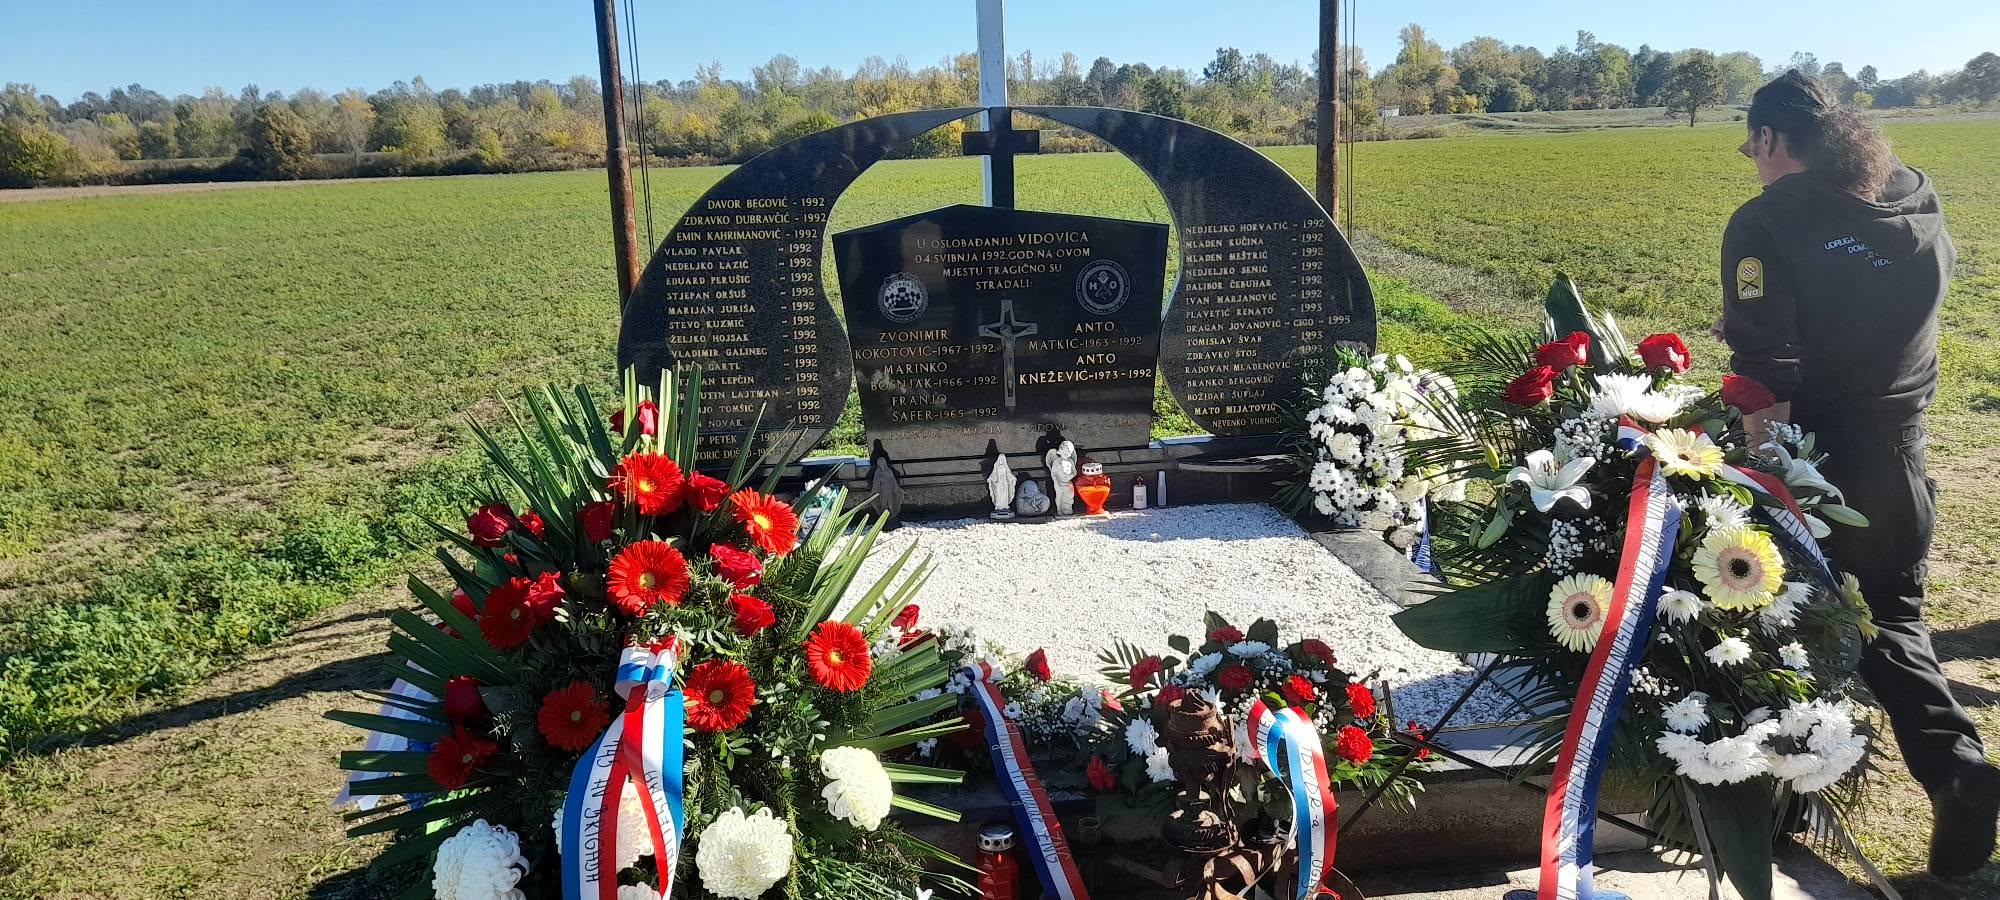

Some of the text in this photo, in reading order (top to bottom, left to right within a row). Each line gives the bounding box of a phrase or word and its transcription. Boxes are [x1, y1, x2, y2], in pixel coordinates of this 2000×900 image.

[708, 196, 824, 209] DAVOR BEGOVIĆ 1992
[684, 212, 827, 226] ZDRAVKO DUBRAVČIĆ 1992
[1185, 219, 1325, 234] NEDJELJKO HORVATIĆ 1992
[677, 229, 818, 242] EMIN KAHRIMANOVIĆ 1992
[917, 232, 1089, 249] U OSLOBAĐANJU VIDOVICA
[1185, 233, 1323, 248] MLADEN KUČINA 1992
[1824, 236, 1856, 250] UDRUGA
[664, 244, 812, 256] VLADO PAVLAK 1992
[1056, 248, 1091, 258] OVOM
[1185, 247, 1323, 262] MLADEN MEŠTRIĆ 1992
[665, 258, 813, 271] NEDELJKO LAZIĆ 1992
[942, 263, 1062, 278] MJESTU TRAGIČNO SU
[1185, 261, 1323, 278] NEDJELJKO SENIĆ 1992
[666, 277, 706, 286] EDUARD
[790, 273, 814, 282] 1992
[975, 279, 1033, 290] STRADALI:
[1185, 282, 1223, 291] DALIBOR
[1300, 275, 1322, 284] 1992
[666, 287, 815, 300] STJEPAN ORŠUŠ 1992
[1185, 289, 1322, 306] IVAN MARJANOVIĆ 1992
[668, 301, 816, 315] MARIJAN JURIŠA 1992
[1236, 306, 1274, 316] RENATO
[1300, 303, 1322, 312] 1993
[668, 321, 700, 330] STEVO
[792, 316, 816, 325] 1992
[1074, 321, 1115, 333] ANTO
[1186, 324, 1224, 333] DRAGAN
[1229, 318, 1281, 331] JOVANOVIĆ
[1328, 316, 1350, 326] 1995
[670, 334, 706, 344] ŽELJKO
[793, 330, 817, 340] 1992
[879, 330, 950, 343] ZVONIMIR
[1120, 336, 1143, 346] 1992
[1186, 330, 1323, 347] TOMISLAV ŠVAB 1993
[671, 344, 817, 358] VLADIMIR GALINEC 1992
[1186, 351, 1230, 360] ZDRAVKO
[794, 358, 818, 368] 1992
[1076, 353, 1116, 366] ANTO
[884, 362, 948, 375] MARINKO
[1128, 368, 1152, 379] 1992
[1185, 364, 1230, 374] RADOVAN
[721, 374, 755, 385] LEPČIN
[795, 372, 819, 382] 1992
[1187, 378, 1224, 388] BRANKO
[731, 390, 779, 399] LAJTMAN
[796, 386, 820, 396] 1992
[797, 400, 821, 410] 1992
[892, 393, 948, 407] FRANJO
[974, 408, 998, 417] 1992
[1194, 406, 1220, 416] MATO
[708, 418, 744, 428] NOVAK
[798, 414, 822, 424] 1992
[1212, 418, 1247, 428] NEVENKO
[710, 434, 738, 444] PETEK
